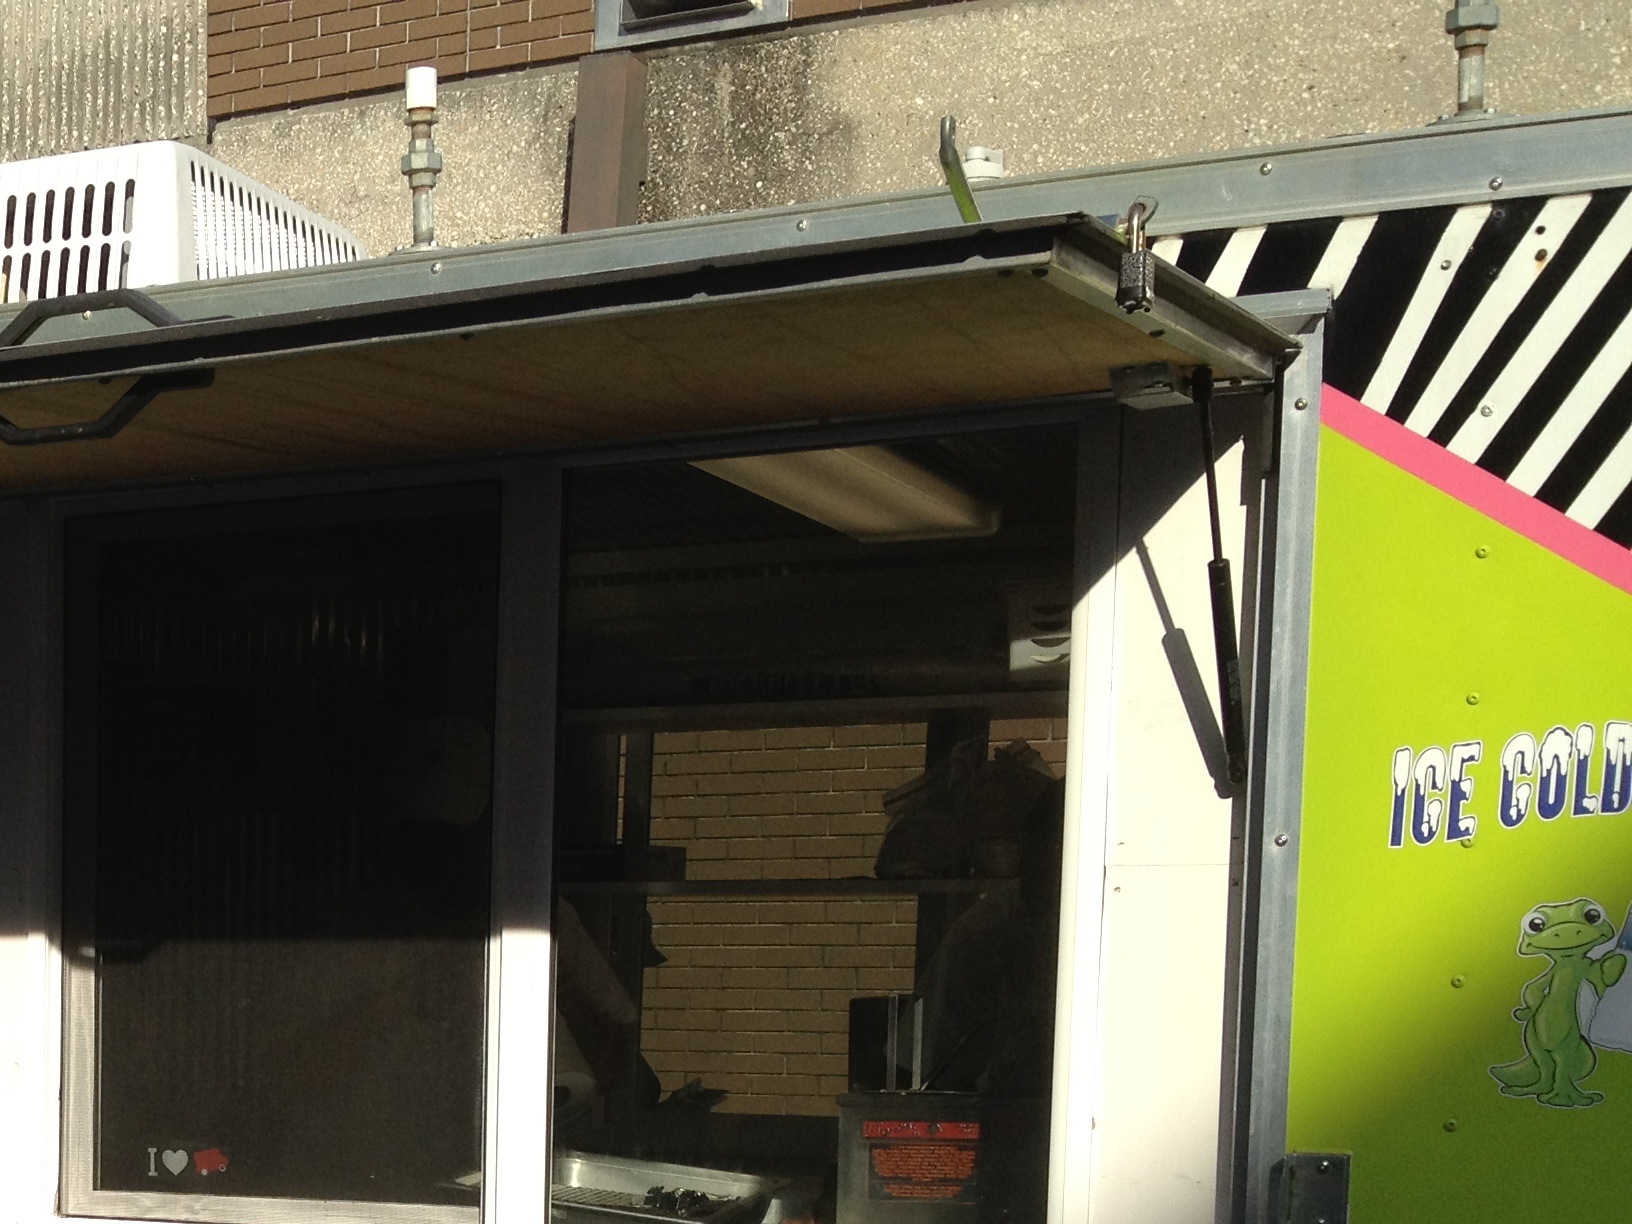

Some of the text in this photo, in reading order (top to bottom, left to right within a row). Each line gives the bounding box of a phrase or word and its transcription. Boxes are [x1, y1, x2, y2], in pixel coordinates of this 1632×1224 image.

[1388, 719, 1632, 848] ICE COLD
[147, 1147, 158, 1177] I
